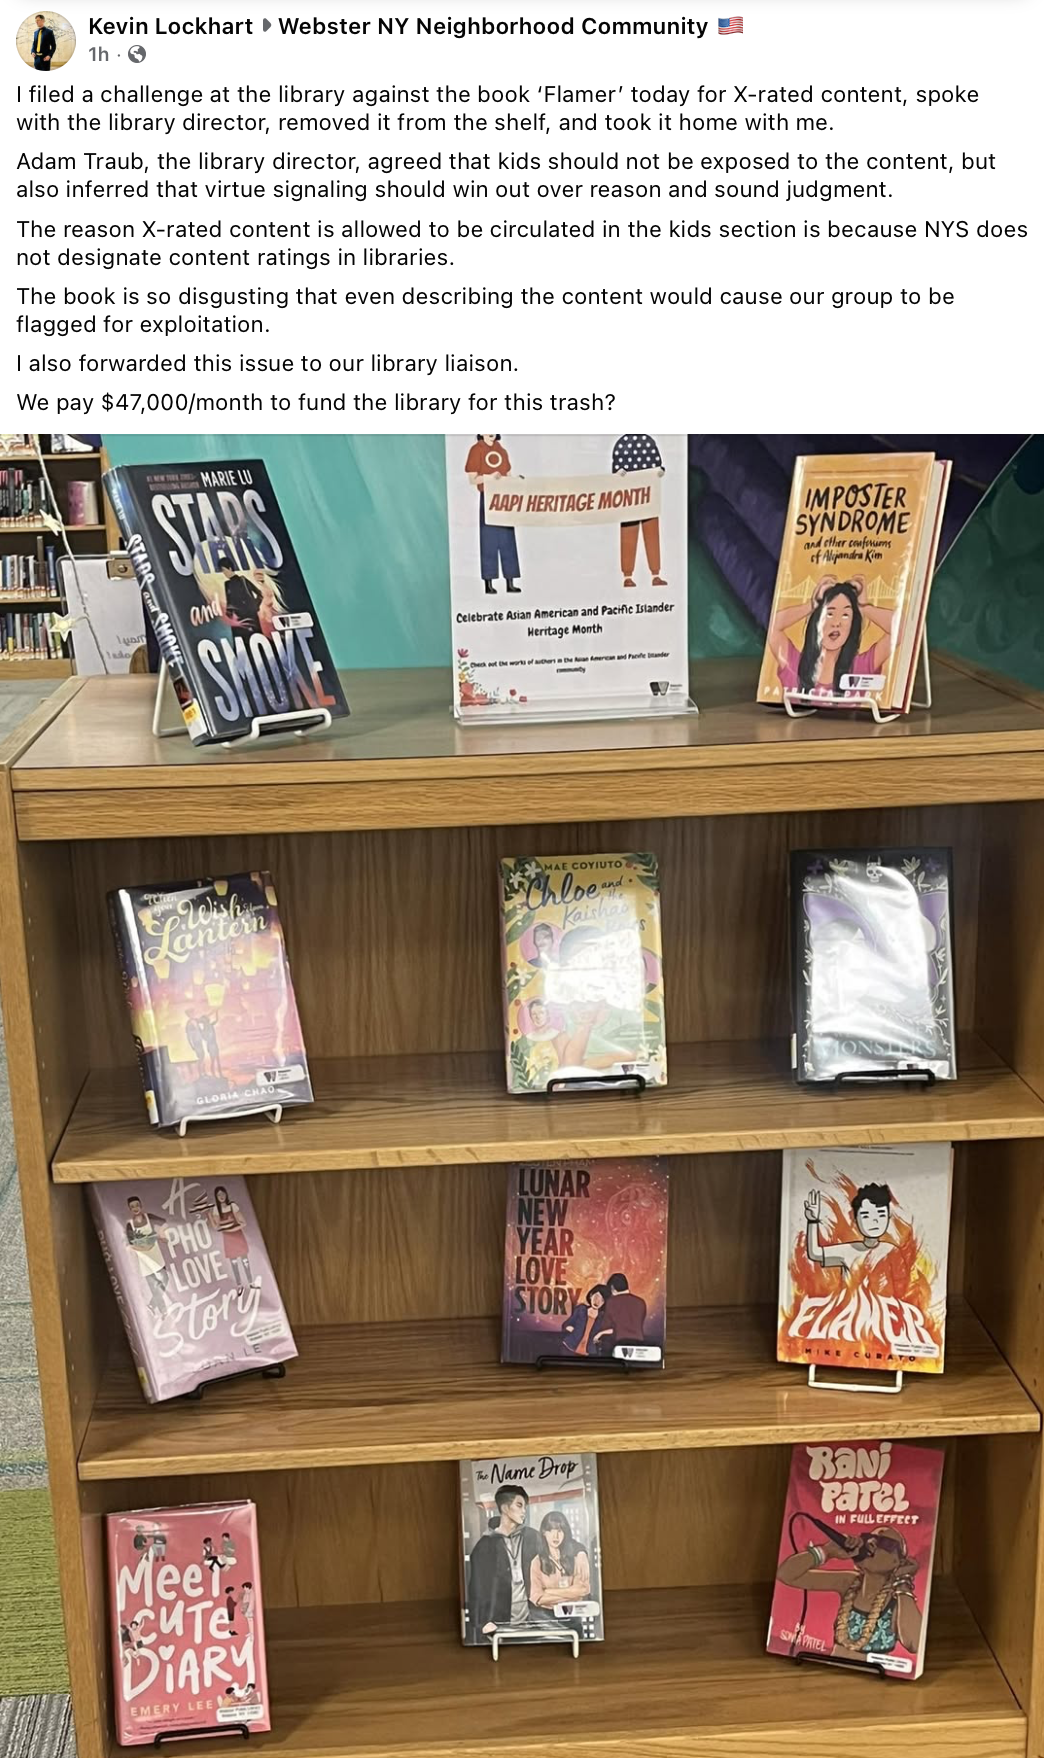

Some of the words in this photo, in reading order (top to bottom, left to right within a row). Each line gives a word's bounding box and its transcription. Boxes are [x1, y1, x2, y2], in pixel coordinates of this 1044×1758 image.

[201, 470, 237, 487] MARIE
[237, 469, 254, 485] LU
[489, 493, 523, 512] AAPI
[526, 492, 596, 513] HERITAGE
[597, 486, 652, 510] MONTH
[805, 483, 907, 512] IMPOSTER
[152, 488, 283, 577] STARS
[795, 508, 911, 537] SYNDROME
[804, 536, 823, 550] and
[824, 537, 846, 549] other
[848, 536, 892, 549] confessions
[811, 549, 822, 564] of
[864, 548, 883, 563] Kim
[190, 593, 223, 627] and
[456, 611, 504, 623] Celebrate
[506, 609, 532, 620] Asian
[534, 608, 579, 619] American
[581, 605, 599, 616] and
[601, 604, 634, 616] Pacific
[635, 602, 675, 614] Islander
[527, 626, 569, 639] Heritage
[572, 623, 603, 634] Month
[198, 625, 336, 722] SMOKE
[544, 862, 568, 871] MAE
[571, 861, 623, 870] COYIUTO
[526, 872, 601, 911] Chloe
[601, 876, 624, 889] and
[177, 893, 242, 930] Wish
[143, 915, 268, 966] Lantern
[196, 1091, 239, 1105] GLORIA
[244, 1085, 275, 1098] CHAO
[519, 1168, 590, 1198] LUNAR
[161, 1178, 200, 1220] A
[517, 1198, 569, 1227] NEW
[516, 1227, 575, 1257] YEAR
[170, 1250, 228, 1294] LOVE
[515, 1256, 567, 1286] LOVE
[514, 1286, 583, 1316] STORY
[788, 1279, 938, 1347] FLAMER
[244, 1343, 262, 1357] LE
[805, 1348, 841, 1358] MIKE
[854, 1352, 917, 1363] CURATO
[475, 1470, 490, 1481] The
[490, 1463, 536, 1485] Name
[538, 1456, 579, 1479] Drop
[835, 1514, 846, 1525] IN
[850, 1514, 875, 1525] FULL
[875, 1514, 920, 1525] EFFECT
[131, 1703, 180, 1718] EMERY
[188, 1700, 214, 1712] LEE
